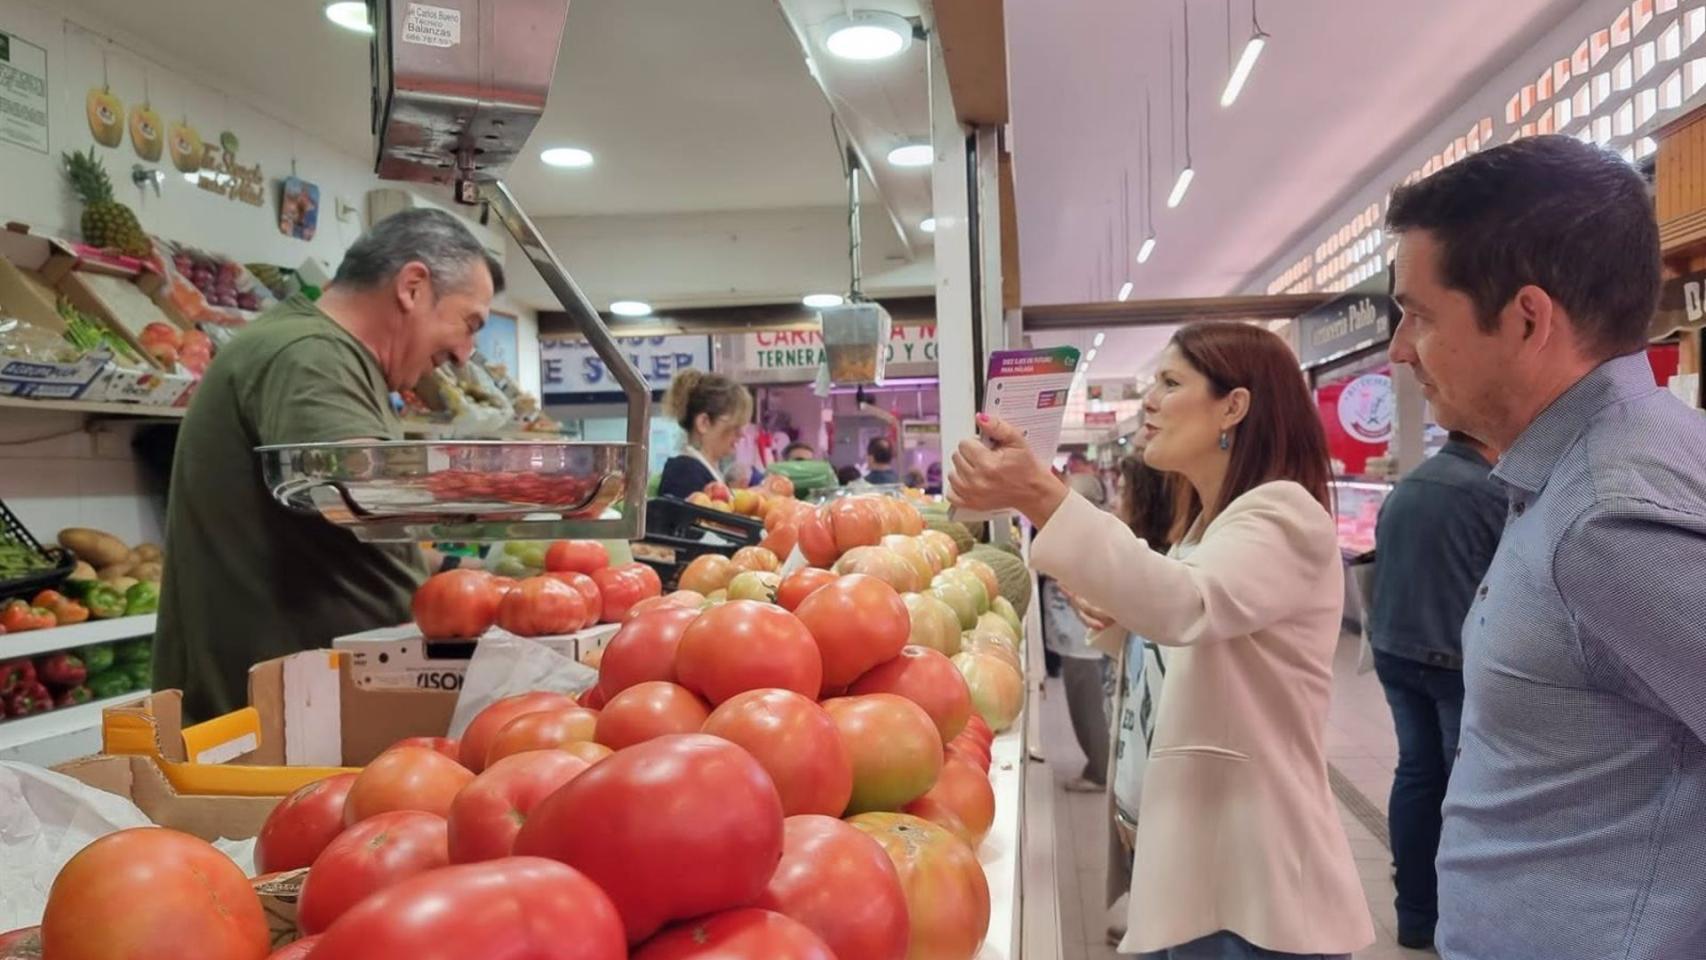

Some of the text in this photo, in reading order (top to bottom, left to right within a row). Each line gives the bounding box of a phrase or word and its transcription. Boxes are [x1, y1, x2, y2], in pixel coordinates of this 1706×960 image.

[407, 22, 452, 37] Balanzas
[1349, 297, 1377, 333] Pablo
[757, 348, 827, 369] TERNERA
